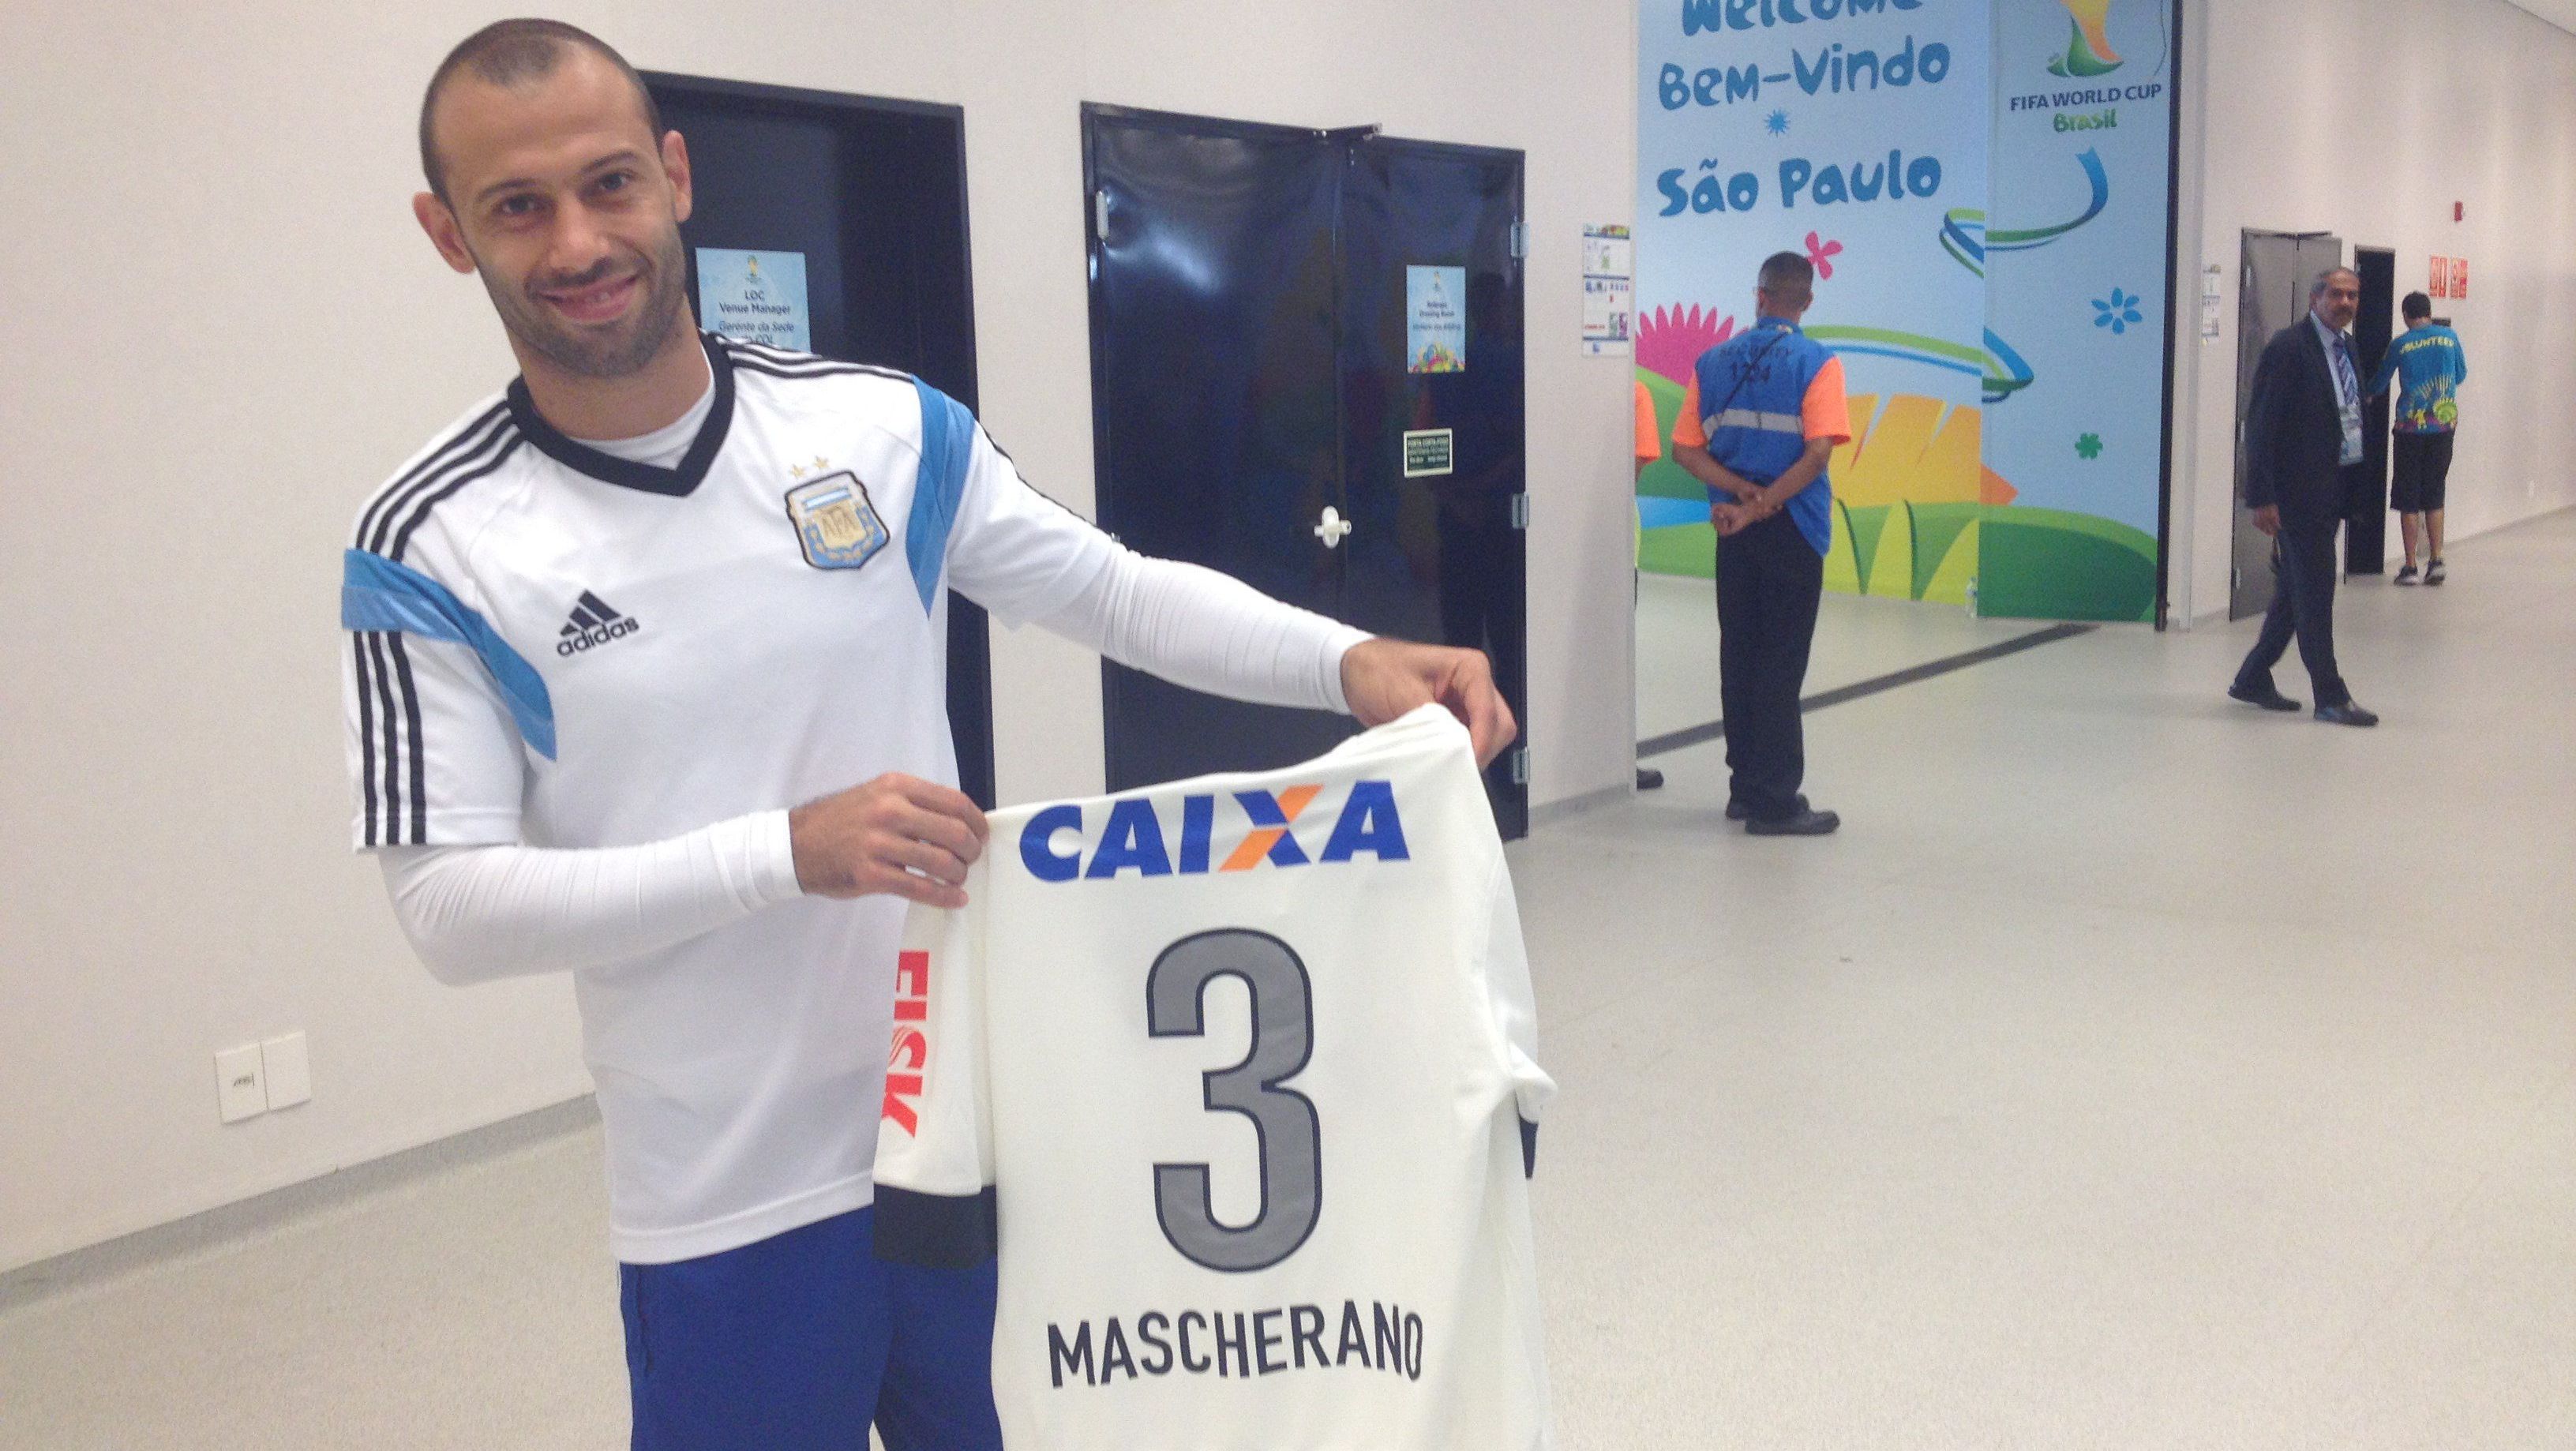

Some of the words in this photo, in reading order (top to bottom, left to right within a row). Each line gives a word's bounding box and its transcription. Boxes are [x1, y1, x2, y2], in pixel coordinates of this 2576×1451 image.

[1682, 0, 1922, 36] Welcom
[2011, 95, 2049, 111] FIFA
[2053, 88, 2122, 107] WORLD
[2124, 83, 2162, 100] CUP
[2053, 108, 2117, 133] Brasil
[1657, 158, 1758, 216] São
[1779, 149, 1941, 208] Paulo
[719, 302, 749, 313] Venue
[752, 303, 790, 316] Manager
[744, 289, 765, 301] LOC
[557, 617, 639, 657] adidas
[1019, 779, 1412, 883] CAIXA
[1146, 927, 1322, 1273] 3
[1047, 1299, 1423, 1389] MASCHERANO
